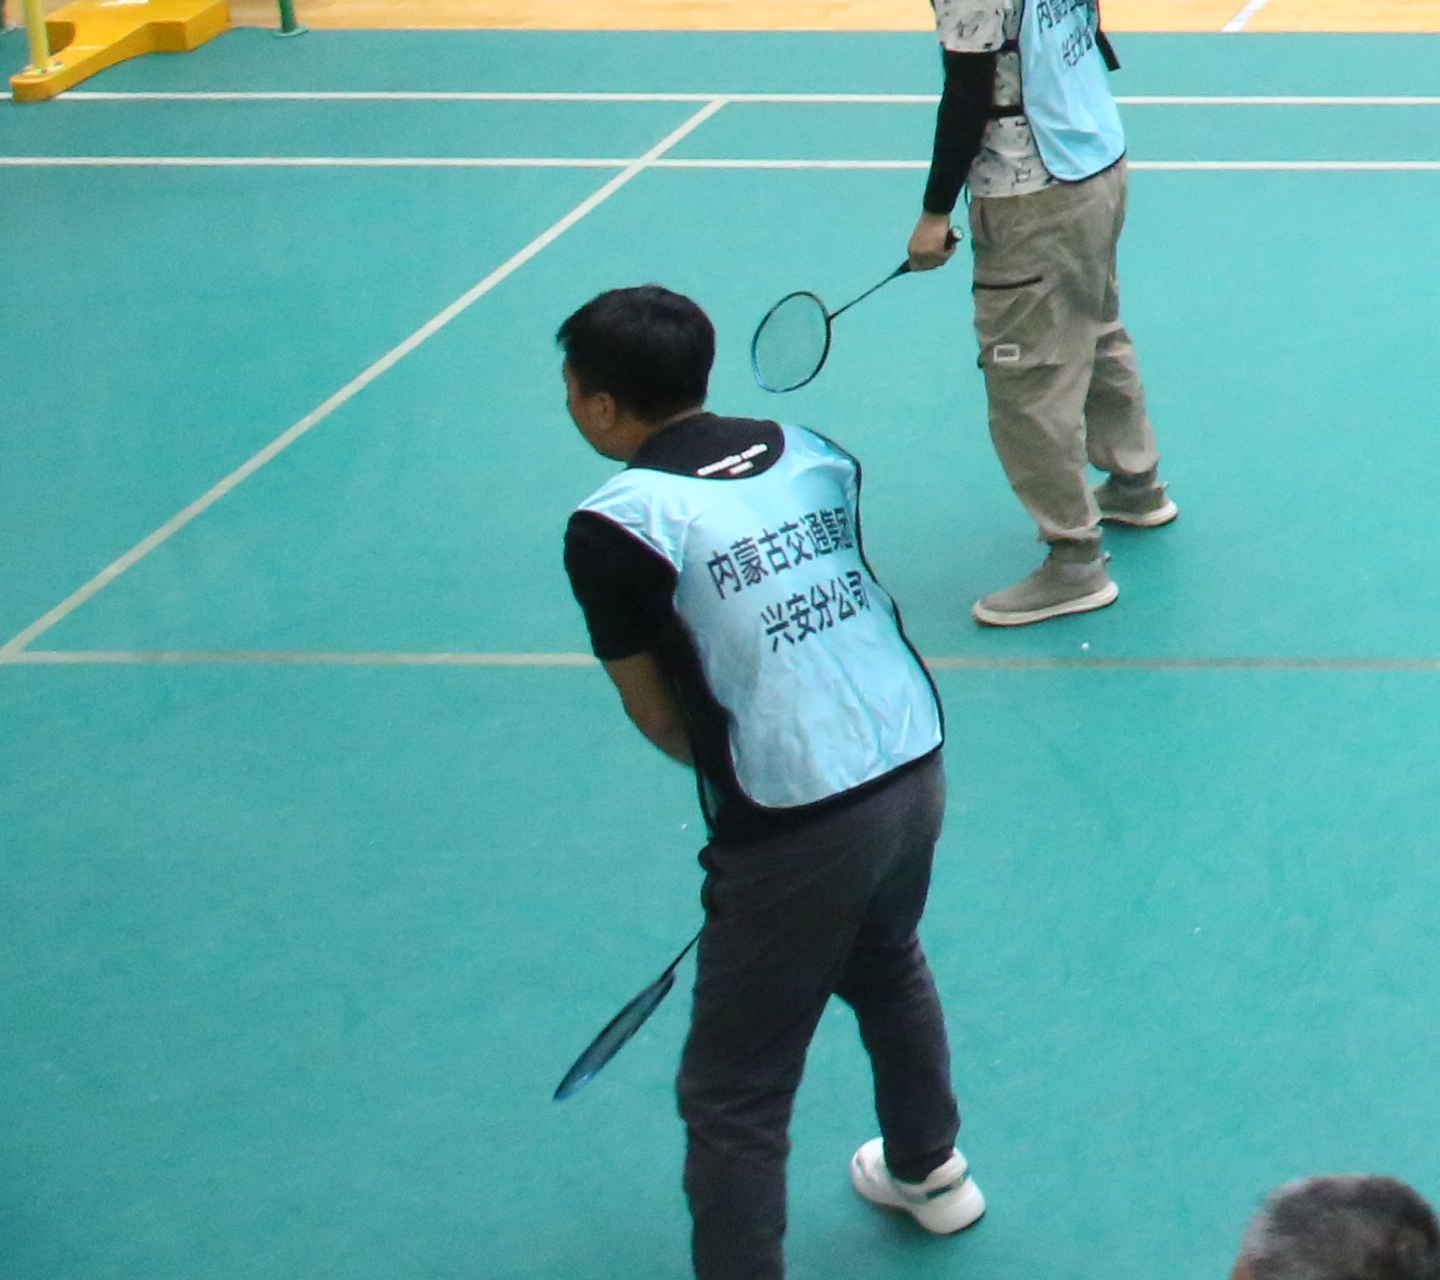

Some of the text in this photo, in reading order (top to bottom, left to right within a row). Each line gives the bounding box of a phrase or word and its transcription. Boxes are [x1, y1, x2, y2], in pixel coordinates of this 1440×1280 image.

[759, 569, 872, 653] 兴安分公司
